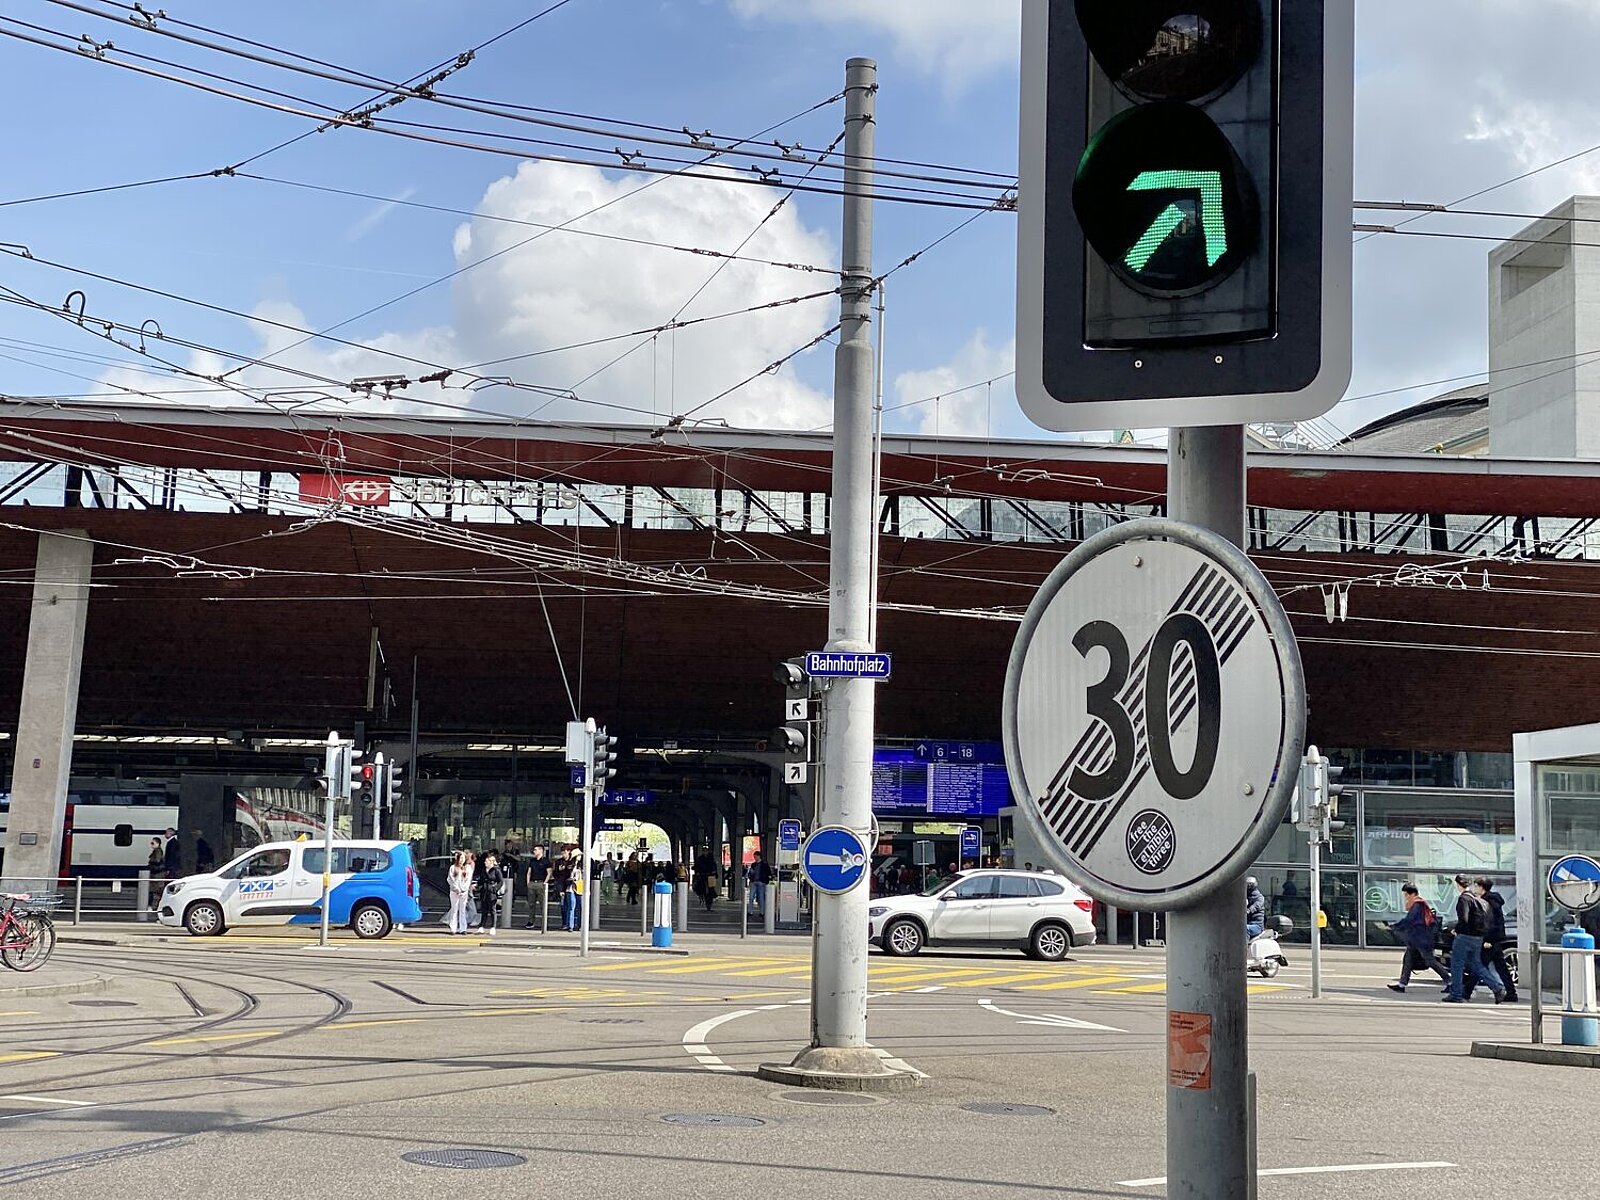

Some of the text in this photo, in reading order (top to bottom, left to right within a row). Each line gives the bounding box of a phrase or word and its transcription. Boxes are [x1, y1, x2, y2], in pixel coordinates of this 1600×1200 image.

[811, 655, 885, 676] Bahnhofplatz
[1067, 613, 1221, 803] 30
[937, 747, 944, 757] 6
[961, 748, 973, 758] 18
[575, 776, 581, 784] 4
[1130, 821, 1148, 842] free
[1143, 825, 1157, 842] the
[1149, 841, 1171, 867] three
